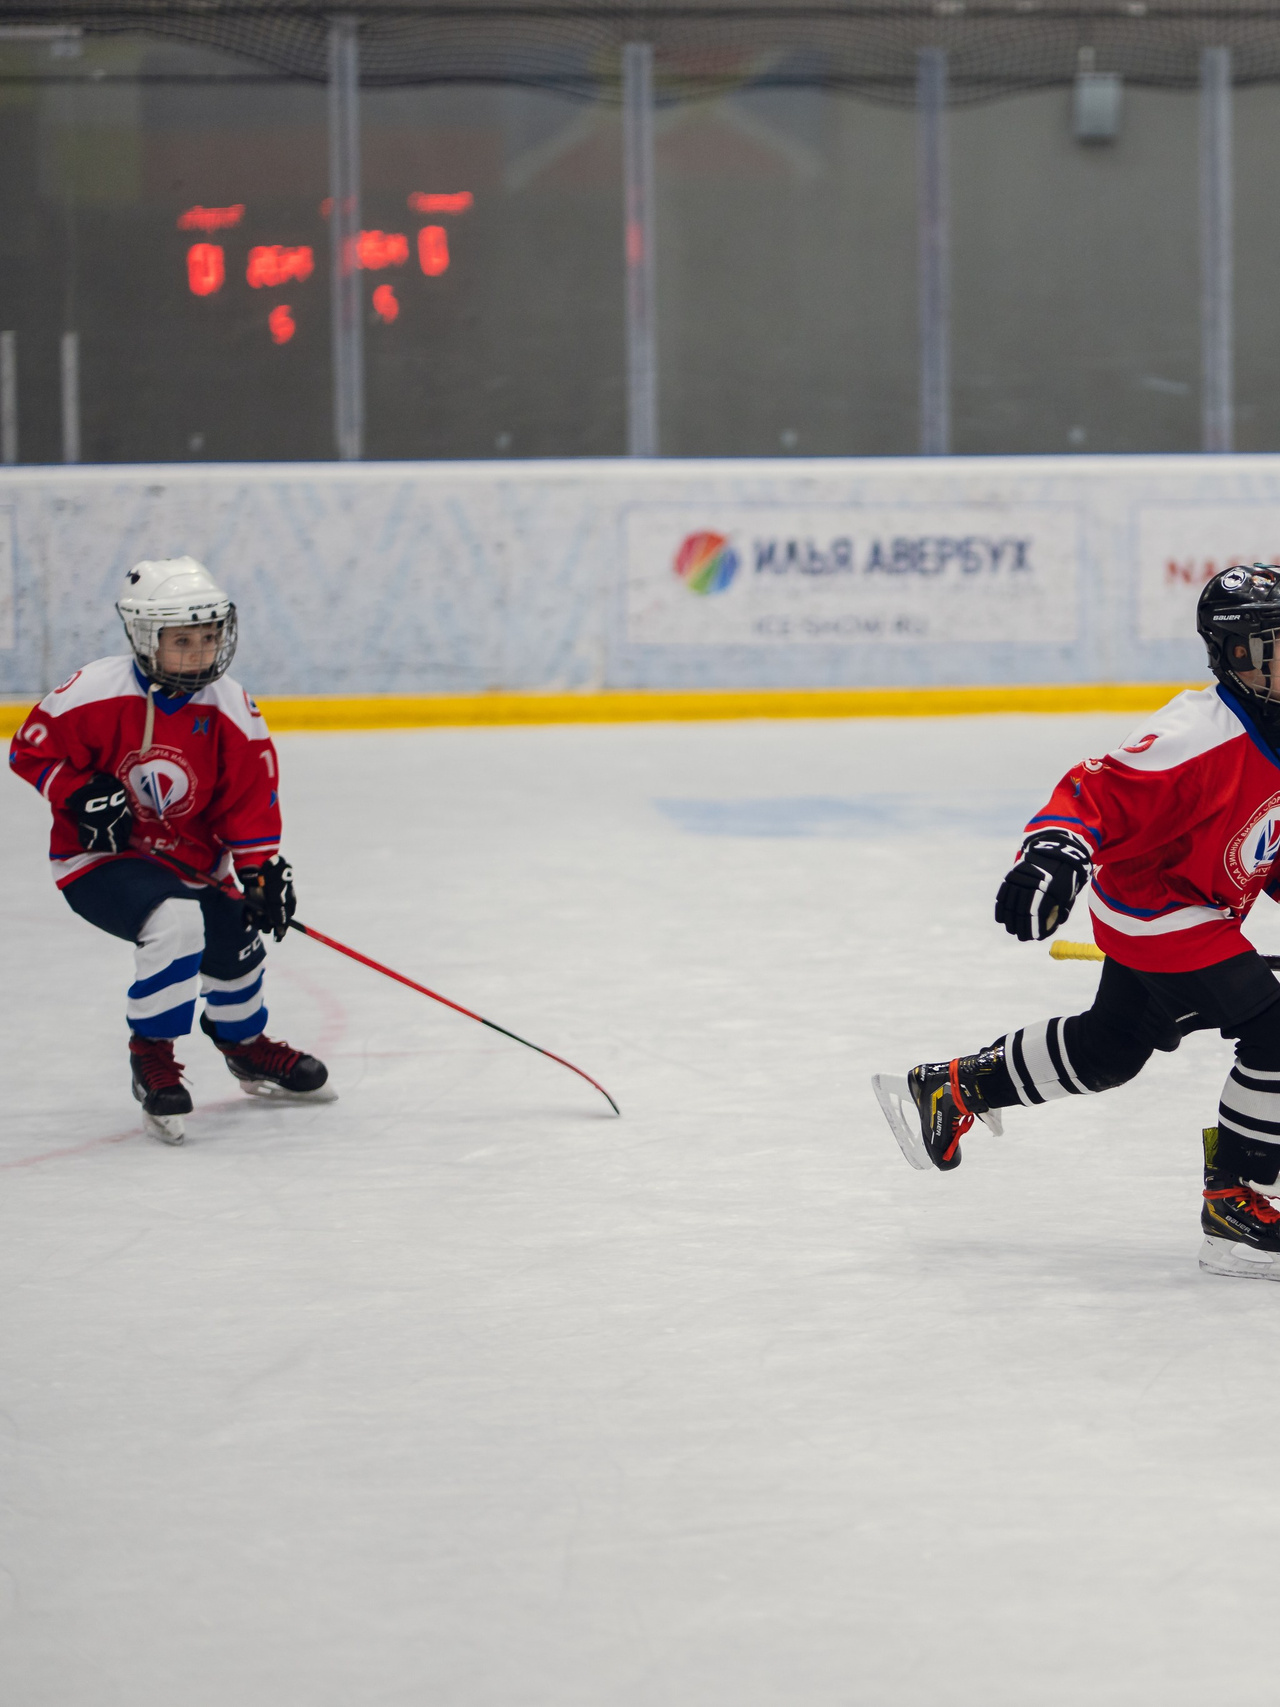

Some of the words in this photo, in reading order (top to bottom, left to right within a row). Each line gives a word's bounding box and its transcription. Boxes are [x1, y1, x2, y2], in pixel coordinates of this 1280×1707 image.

[753, 536, 855, 577] ИЛЬЯ
[864, 536, 1034, 576] АВЕРБУХ
[1228, 837, 1243, 867] ЗИМНИХ
[1225, 1215, 1252, 1233] BAUER
